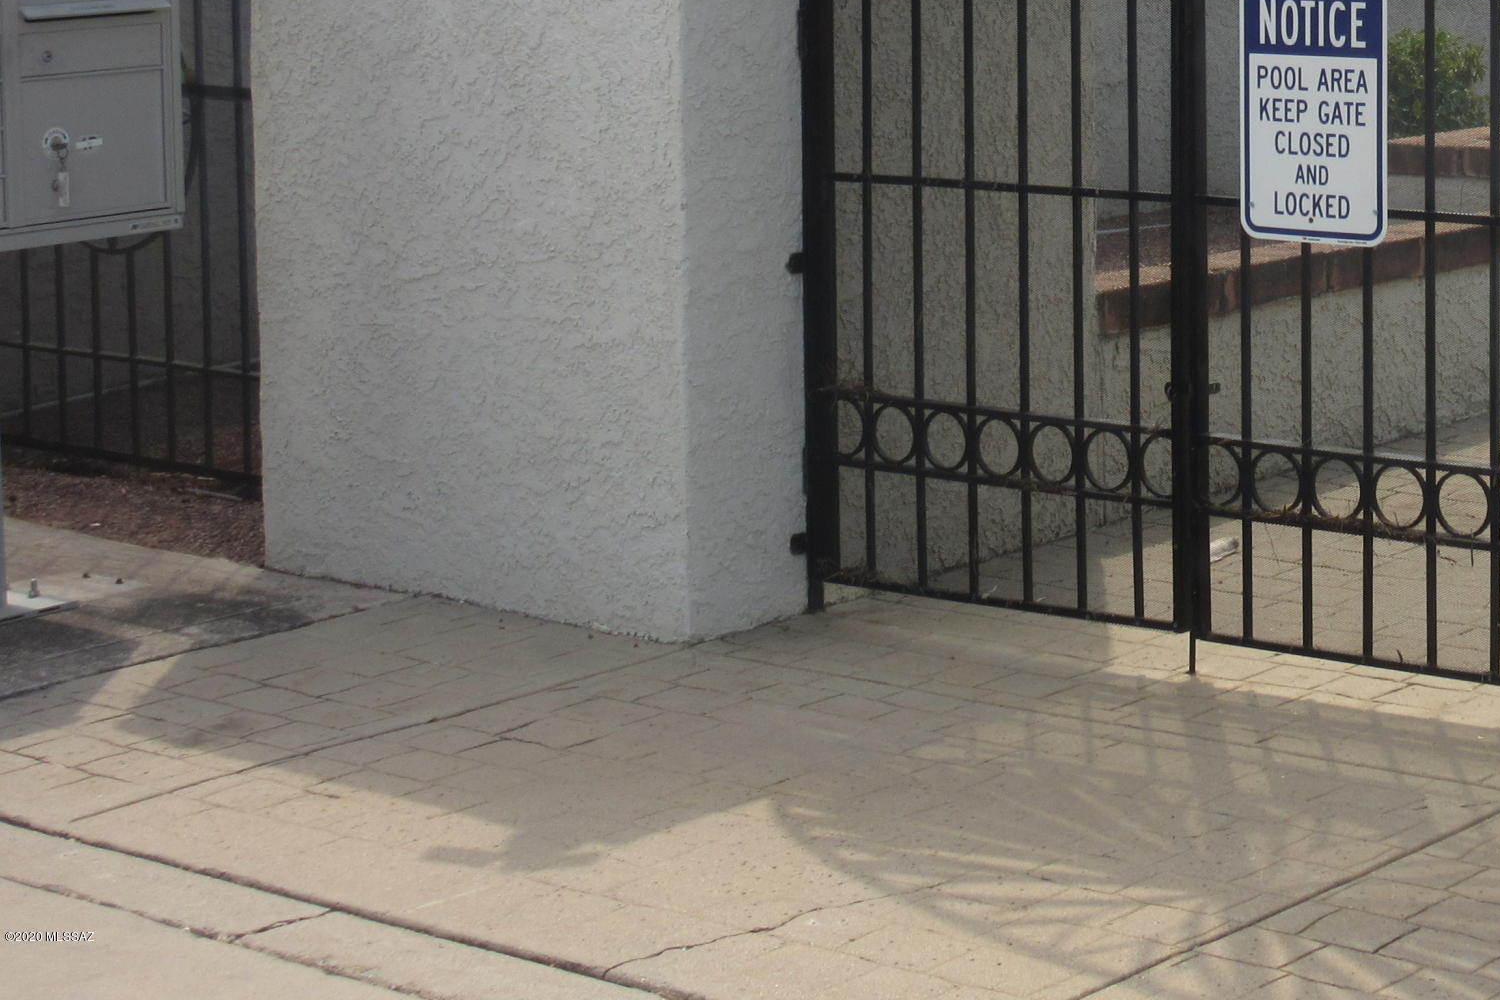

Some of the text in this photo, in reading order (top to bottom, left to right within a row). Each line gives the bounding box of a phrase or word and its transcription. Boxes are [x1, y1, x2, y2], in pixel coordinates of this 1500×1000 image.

[1256, 65, 1368, 94] POOL AREA
[1259, 97, 1366, 127] KEEP GATE
[1274, 130, 1350, 158] CLOSED
[1295, 164, 1329, 186] AND
[1274, 191, 1350, 220] LOCKED
